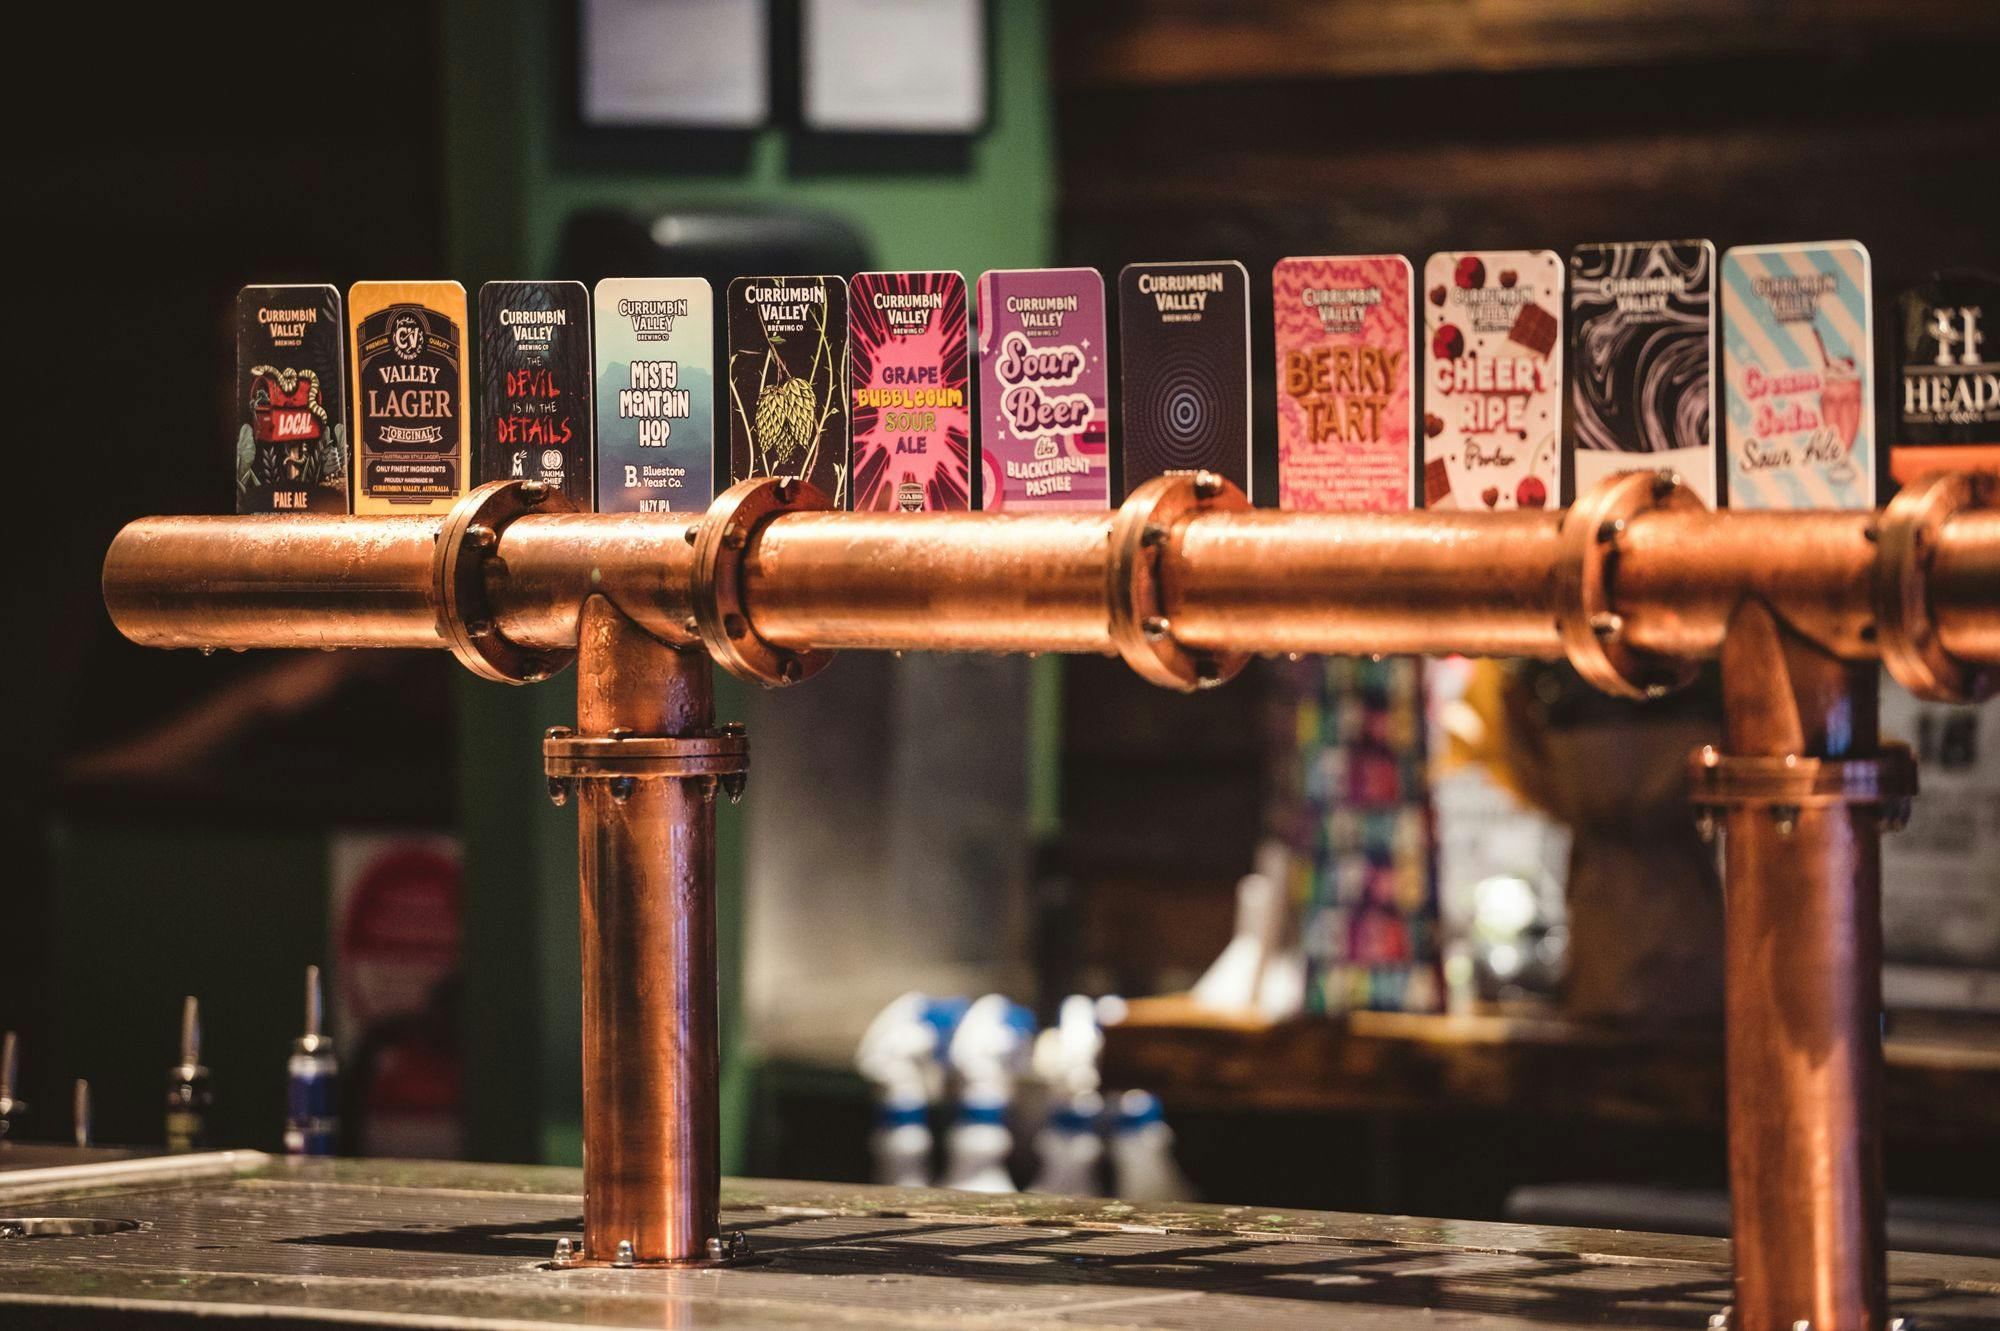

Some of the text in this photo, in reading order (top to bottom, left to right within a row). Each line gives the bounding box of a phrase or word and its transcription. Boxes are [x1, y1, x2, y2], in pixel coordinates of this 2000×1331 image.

[1138, 272, 1223, 294] CURRUMBIN
[745, 285, 825, 304] CURRUMBIN
[873, 293, 943, 310] CURRUMBIN
[1006, 294, 1078, 313] CURRUMBIN
[1155, 291, 1207, 311] VALLEY
[258, 308, 317, 323] CURRUMBIN
[618, 299, 688, 316] CURRUMBIN
[760, 303, 810, 322] VALLEY
[887, 309, 930, 325] VALLEY
[1318, 304, 1367, 322] VALLEY
[500, 309, 566, 326] CURRUMBIN
[632, 316, 674, 332] VALLEY
[1020, 311, 1064, 328] VALLEY
[270, 323, 305, 338] VALLEY
[513, 326, 553, 341] VALLEY
[366, 337, 450, 351] PREMIUM QUALITY
[527, 357, 542, 367] THE
[1000, 337, 1082, 384] Sour
[379, 365, 441, 384] VALLEY
[882, 366, 938, 385] GRAPE
[1285, 347, 1400, 397] BERRY
[1436, 357, 1551, 395] CHEERY
[506, 369, 561, 399] DEVIL
[1904, 374, 2000, 414] HEAD
[368, 390, 453, 418] LAGER
[512, 401, 557, 413] IS IN THE
[1005, 386, 1090, 433] Beer
[884, 412, 936, 433] SOUR
[1299, 396, 1389, 444] TART
[1460, 394, 1528, 434] RIPE
[278, 413, 312, 436] LOCAL
[498, 415, 572, 445] DETAILS
[638, 419, 671, 448] HOP
[390, 429, 434, 440] ORIGINAL
[895, 436, 927, 454] ALE
[1740, 430, 1842, 474] Sour Ale
[376, 465, 446, 473] ONLY FINEST INGREDIENTS
[540, 470, 565, 478] YAKIMA
[643, 465, 686, 477] Bluestone
[643, 477, 683, 488] Yeast Co.
[1025, 476, 1072, 496] PASTILLE
[273, 492, 308, 508] PALE ALE
[639, 499, 658, 512] HAZY
